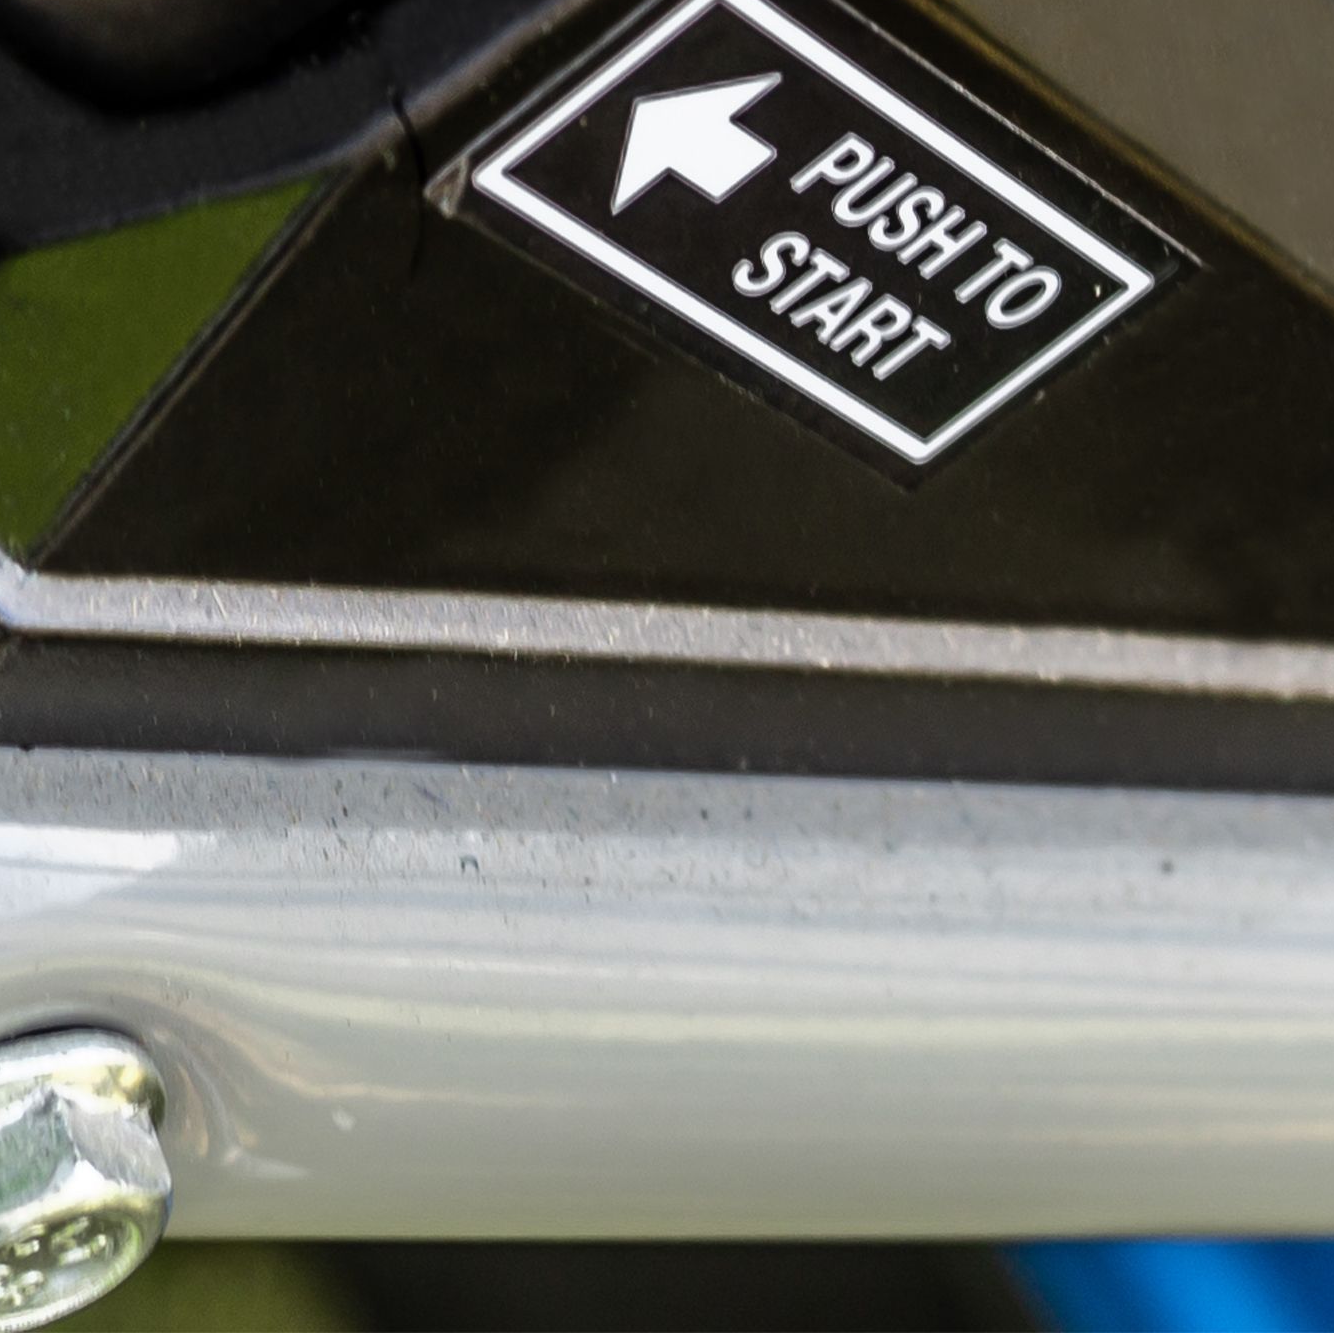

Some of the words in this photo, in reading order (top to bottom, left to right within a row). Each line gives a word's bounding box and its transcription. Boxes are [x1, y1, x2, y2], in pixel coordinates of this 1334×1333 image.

[731, 231, 952, 381] START
[789, 131, 988, 281] PUSH
[953, 237, 1063, 330] TO
